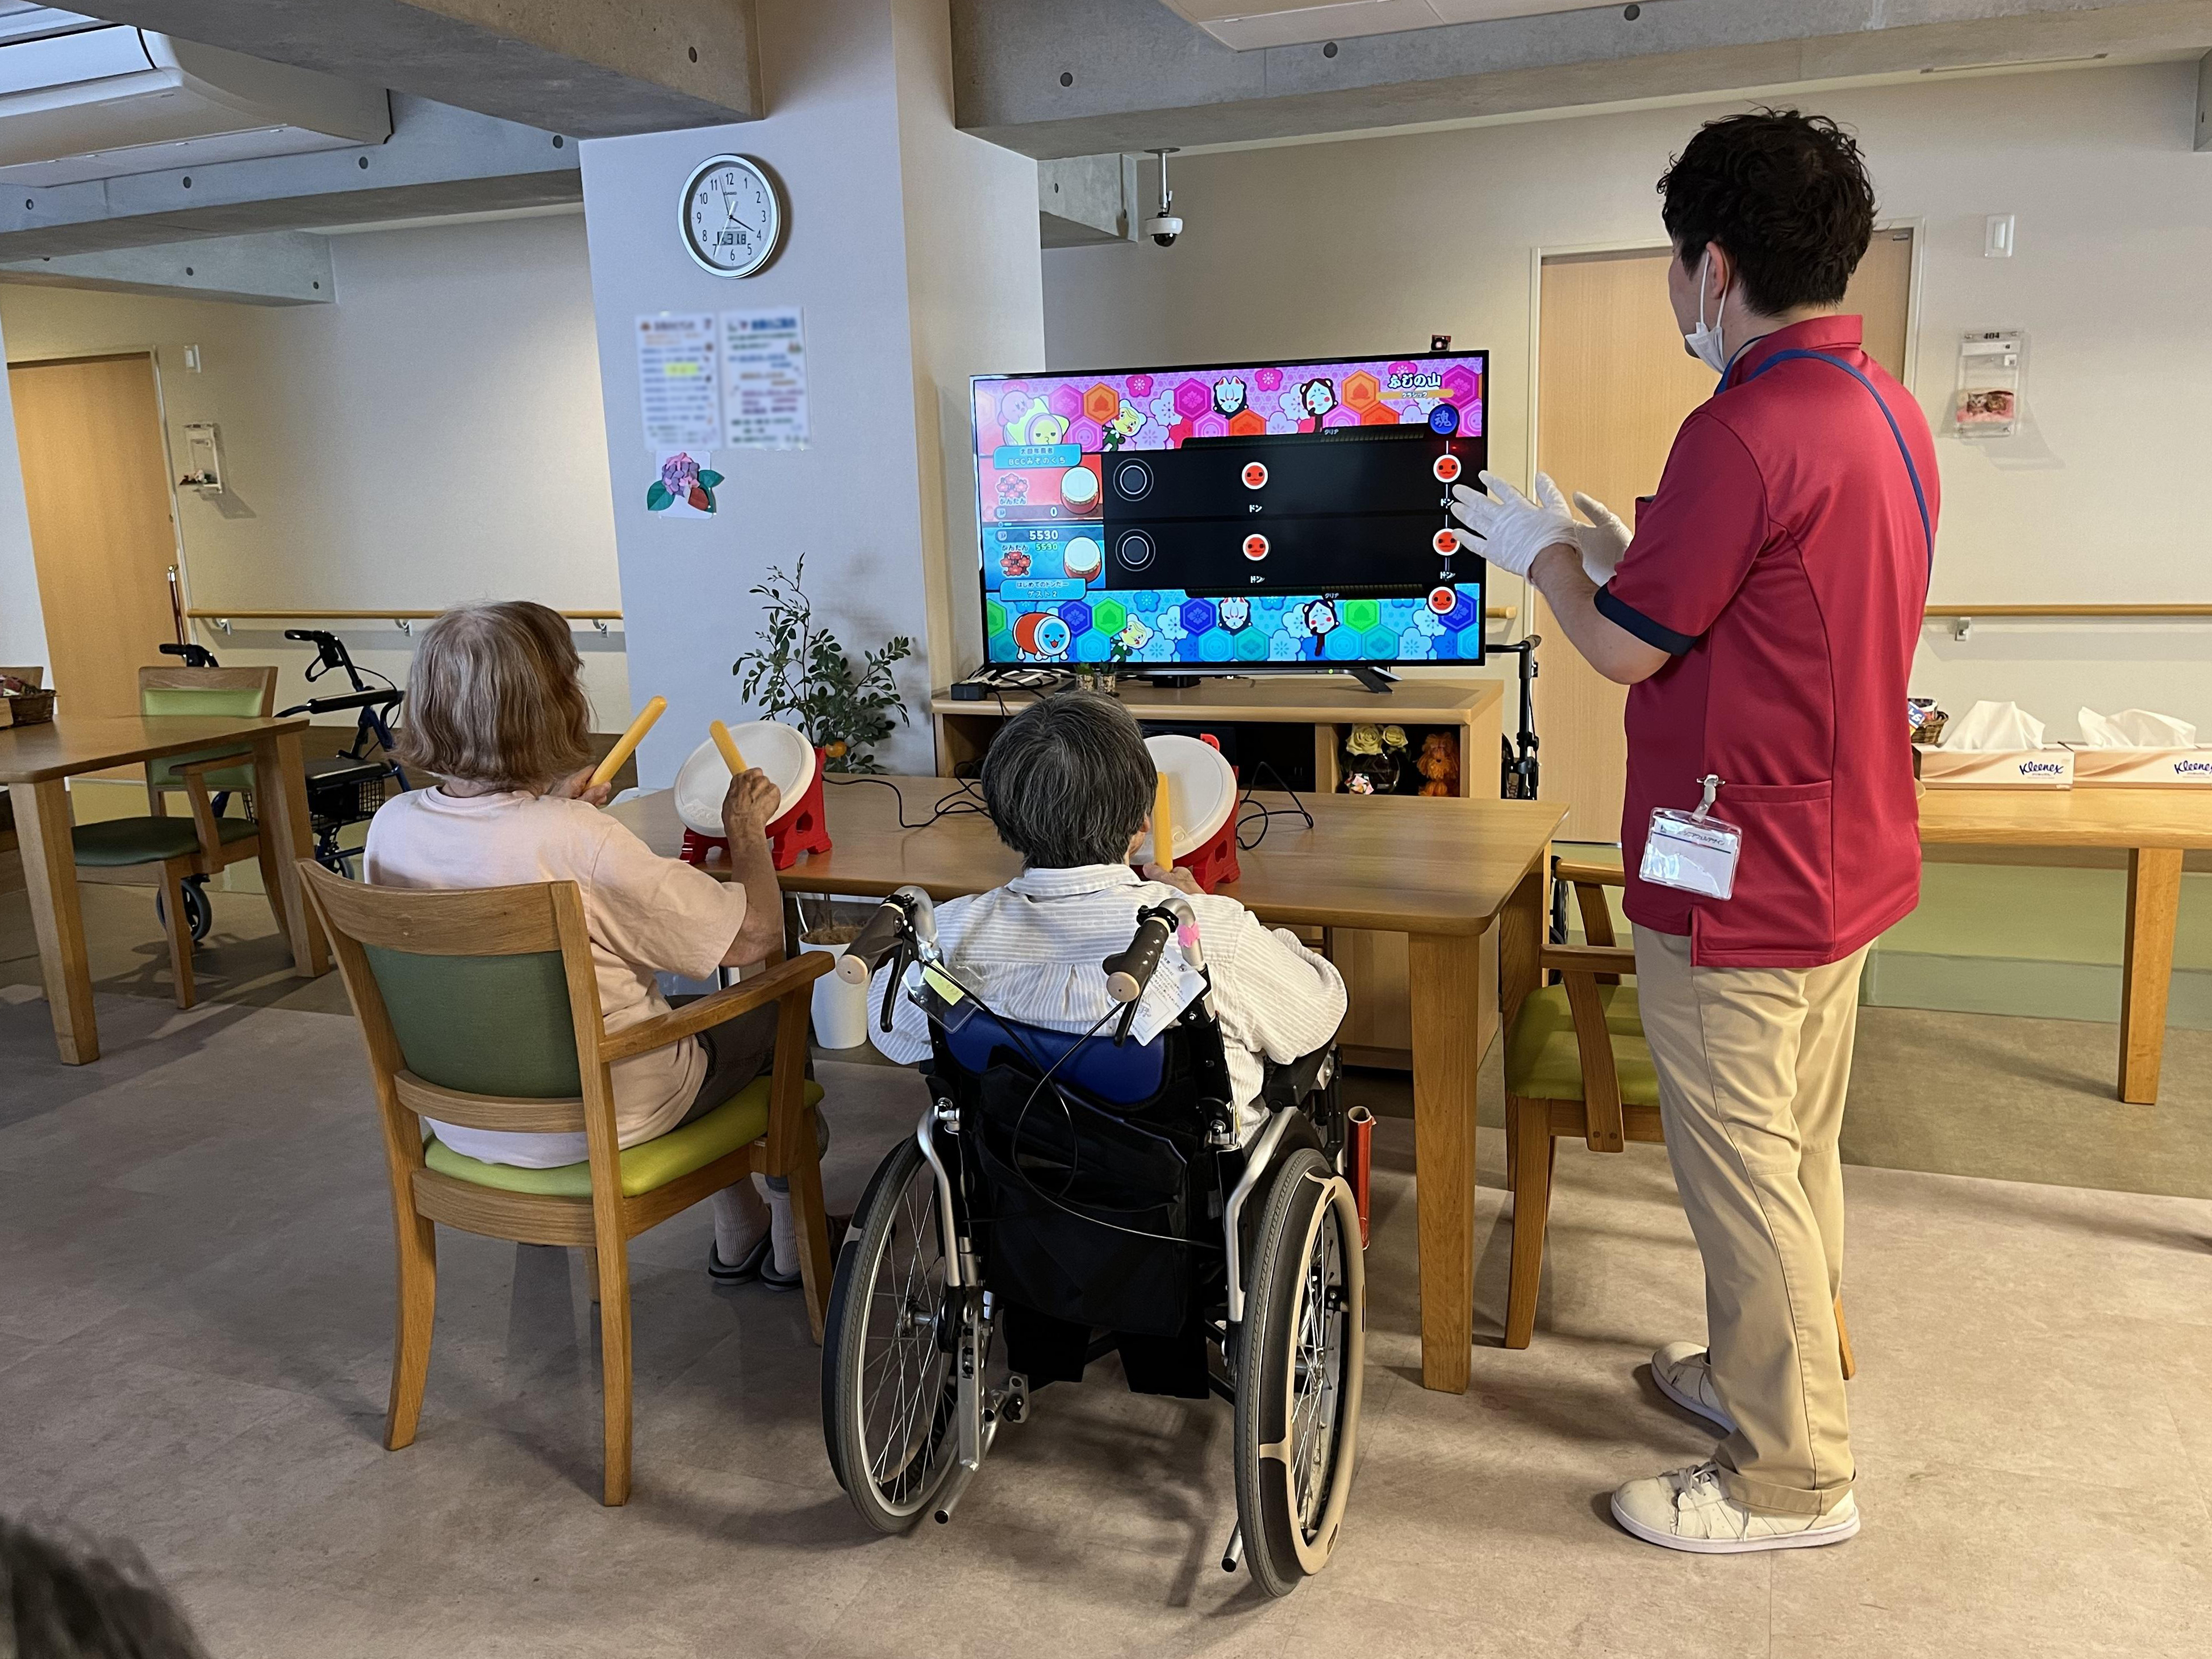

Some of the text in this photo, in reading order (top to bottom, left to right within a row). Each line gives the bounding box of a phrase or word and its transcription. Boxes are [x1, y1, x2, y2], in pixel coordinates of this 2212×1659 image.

[710, 179, 718, 191] 11
[725, 173, 734, 185] 12
[744, 177, 748, 189] 1
[700, 192, 708, 205] 10
[757, 191, 761, 203] 2
[696, 212, 702, 224] 9
[761, 210, 766, 222] 3
[702, 230, 708, 241] 8
[757, 230, 762, 241] 4
[712, 244, 717, 256] 7
[730, 248, 735, 261] 6
[747, 243, 752, 255] 5
[1388, 373, 1441, 389] ふじの山
[1434, 410, 1452, 427] 魂
[1009, 456, 1066, 465] BCCみそのくち
[1441, 498, 1454, 507] ドン
[1050, 507, 1058, 517] 0
[1029, 530, 1058, 541] 5530
[2019, 761, 2064, 775] Kleenex
